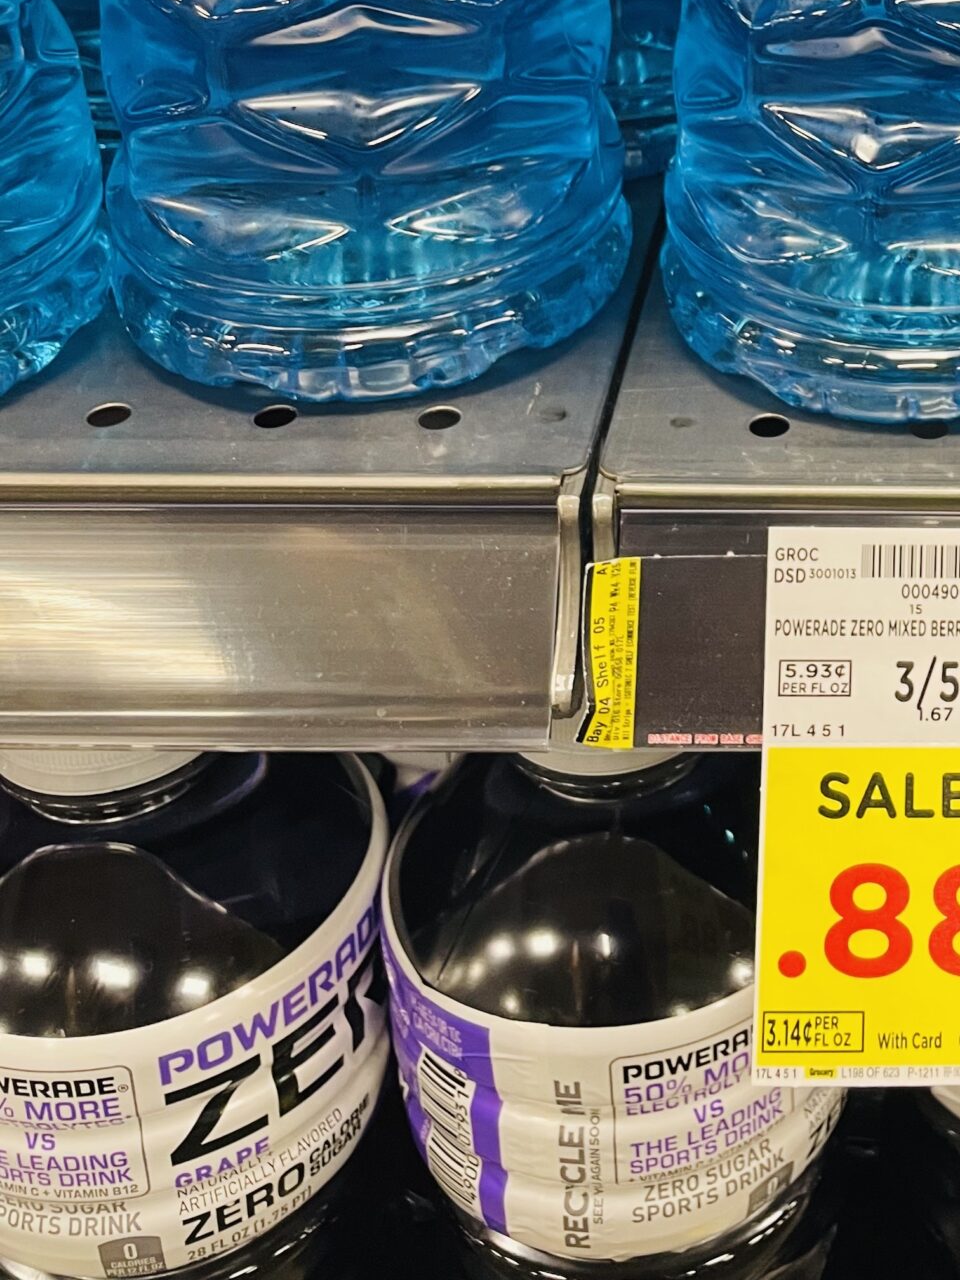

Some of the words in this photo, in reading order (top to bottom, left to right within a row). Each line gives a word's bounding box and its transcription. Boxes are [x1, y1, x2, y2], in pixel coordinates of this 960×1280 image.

[775, 547, 819, 562] GROC
[774, 568, 806, 583] DSD
[809, 568, 856, 579] 3001013
[594, 617, 605, 634] 05
[774, 619, 846, 637] POWERADE
[851, 620, 884, 637] ZERO
[889, 620, 927, 637] MIXED
[594, 645, 609, 688] Shelf
[782, 683, 807, 693] PER
[811, 683, 825, 693] FL
[830, 683, 848, 693] OZ
[601, 697, 610, 715] 04
[918, 708, 953, 721] 1.67
[587, 721, 607, 742] Bay
[772, 724, 801, 737] 17L
[807, 724, 816, 737] 4
[822, 724, 831, 737] 5
[814, 1017, 838, 1030] PER
[814, 1033, 830, 1047] FL
[833, 1033, 851, 1046] OZ
[877, 1031, 909, 1050] With
[912, 1031, 942, 1049] Card
[25, 1097, 121, 1121] MORE
[693, 1099, 724, 1124] VS
[630, 1136, 678, 1157] THE
[687, 1087, 782, 1147] LEADING
[25, 1132, 55, 1150] VS
[630, 1140, 717, 1174] SPORTS
[725, 1100, 783, 1147] DRINK
[17, 1151, 128, 1171] LEADING
[175, 1137, 269, 1188] GRAPE
[179, 1161, 277, 1216] ARTIFICIALLY
[280, 1107, 343, 1168] FLAVORED
[59, 1167, 133, 1187] DRINK
[632, 1188, 719, 1224] SPORTS
[725, 1147, 784, 1197] DRINK
[54, 1187, 108, 1198] VITAMIN
[113, 1184, 139, 1196] B12
[643, 1174, 699, 1203] ZERO
[182, 1162, 305, 1246] ZERO
[69, 1211, 142, 1237] DRINK
[123, 1243, 138, 1260] 0
[188, 1246, 206, 1261] 28
[211, 1238, 228, 1252] FL
[232, 1226, 250, 1242] OZ
